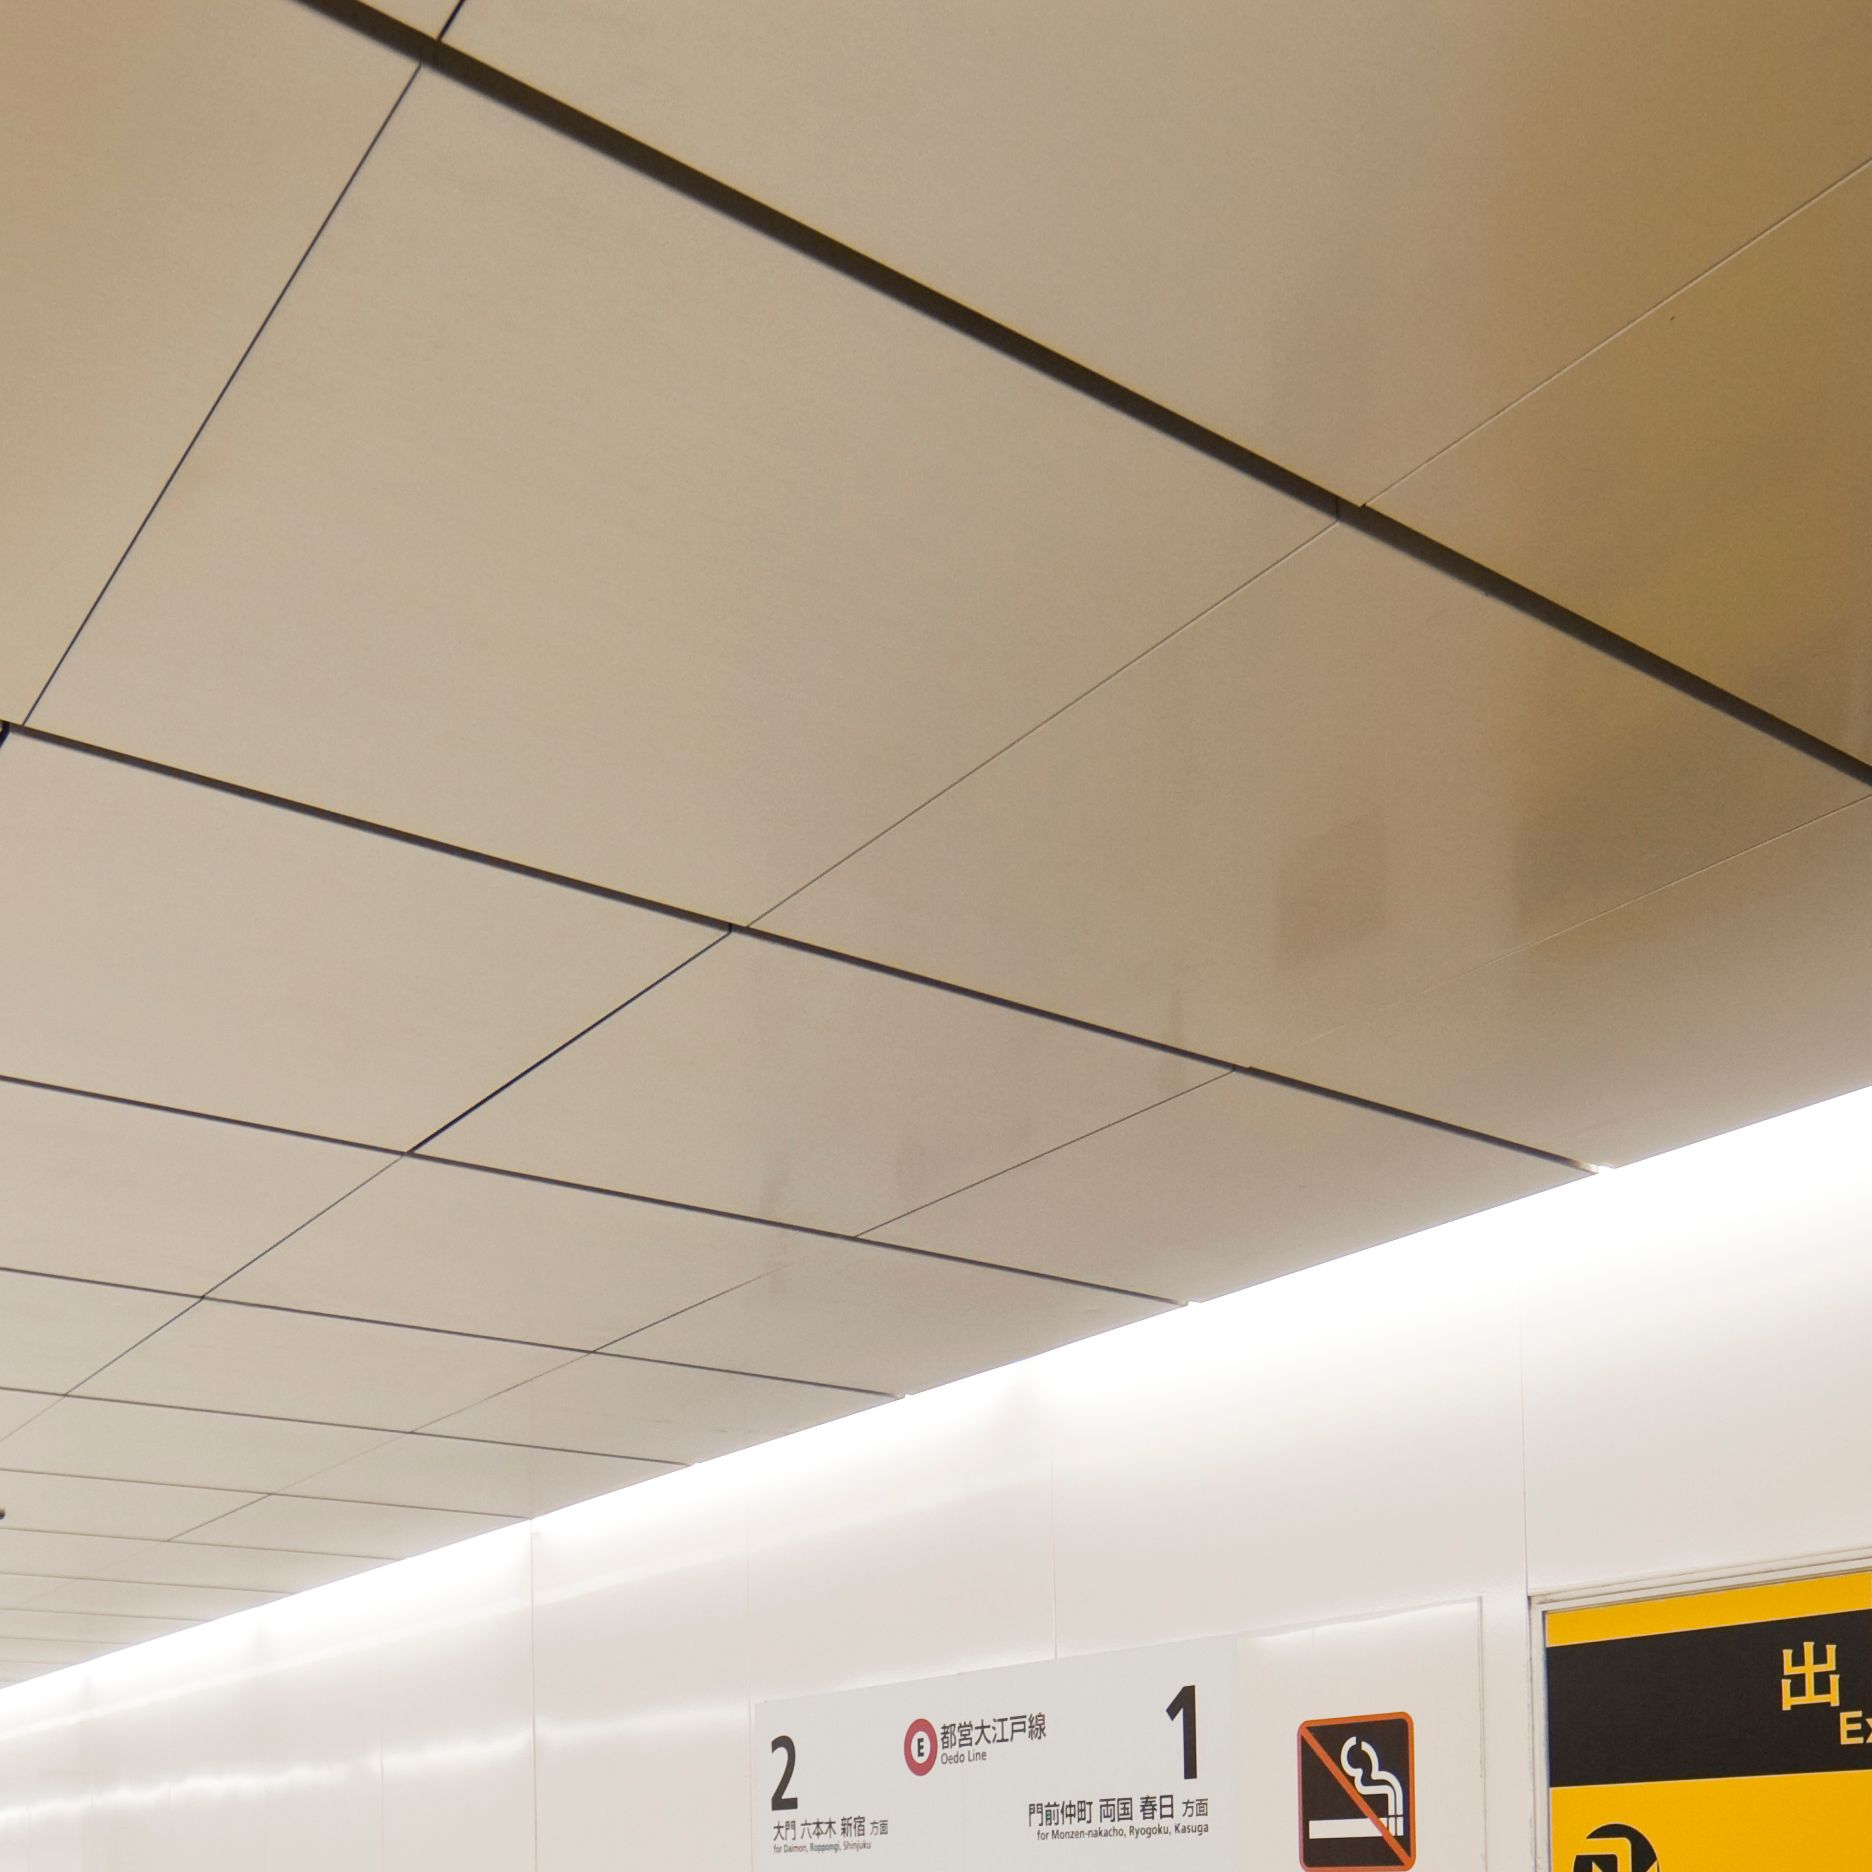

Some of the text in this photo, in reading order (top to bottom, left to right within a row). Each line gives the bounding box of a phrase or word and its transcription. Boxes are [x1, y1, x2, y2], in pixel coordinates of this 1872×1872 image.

[940, 1712, 1046, 1750] 都営大江戸線
[1166, 1685, 1197, 1779] 1
[918, 1738, 924, 1757] E
[941, 1750, 987, 1765] Oedo Line
[771, 1735, 798, 1811] 2
[1028, 1795, 1208, 1827] 門前仲町 両国 春日 方面
[773, 1816, 888, 1841] 大門 六本木 新宿 方面
[1037, 1823, 1209, 1840] for Monzen-nakacho, Ryogoku, Kasuga
[773, 1844, 782, 1853] for
[843, 1841, 871, 1852] Shinjuku
